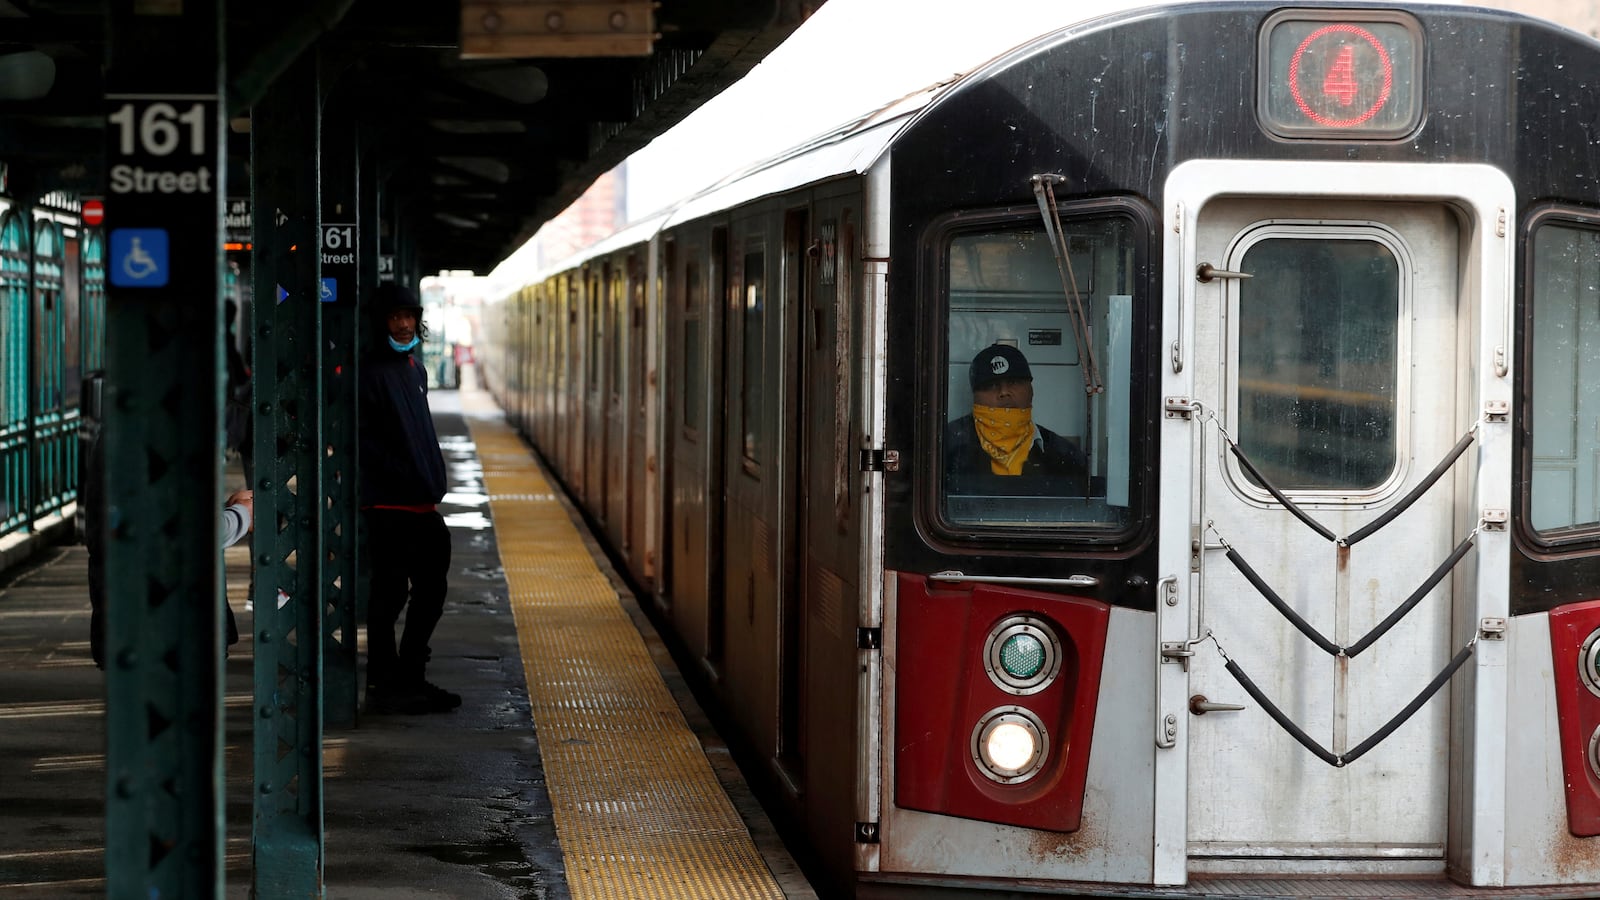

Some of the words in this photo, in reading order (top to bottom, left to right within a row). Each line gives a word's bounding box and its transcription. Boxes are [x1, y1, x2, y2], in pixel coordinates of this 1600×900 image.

[1323, 45, 1358, 106] 4
[108, 102, 206, 156] 161
[110, 164, 211, 193] Street
[320, 227, 352, 249] 61
[320, 252, 354, 264] treet
